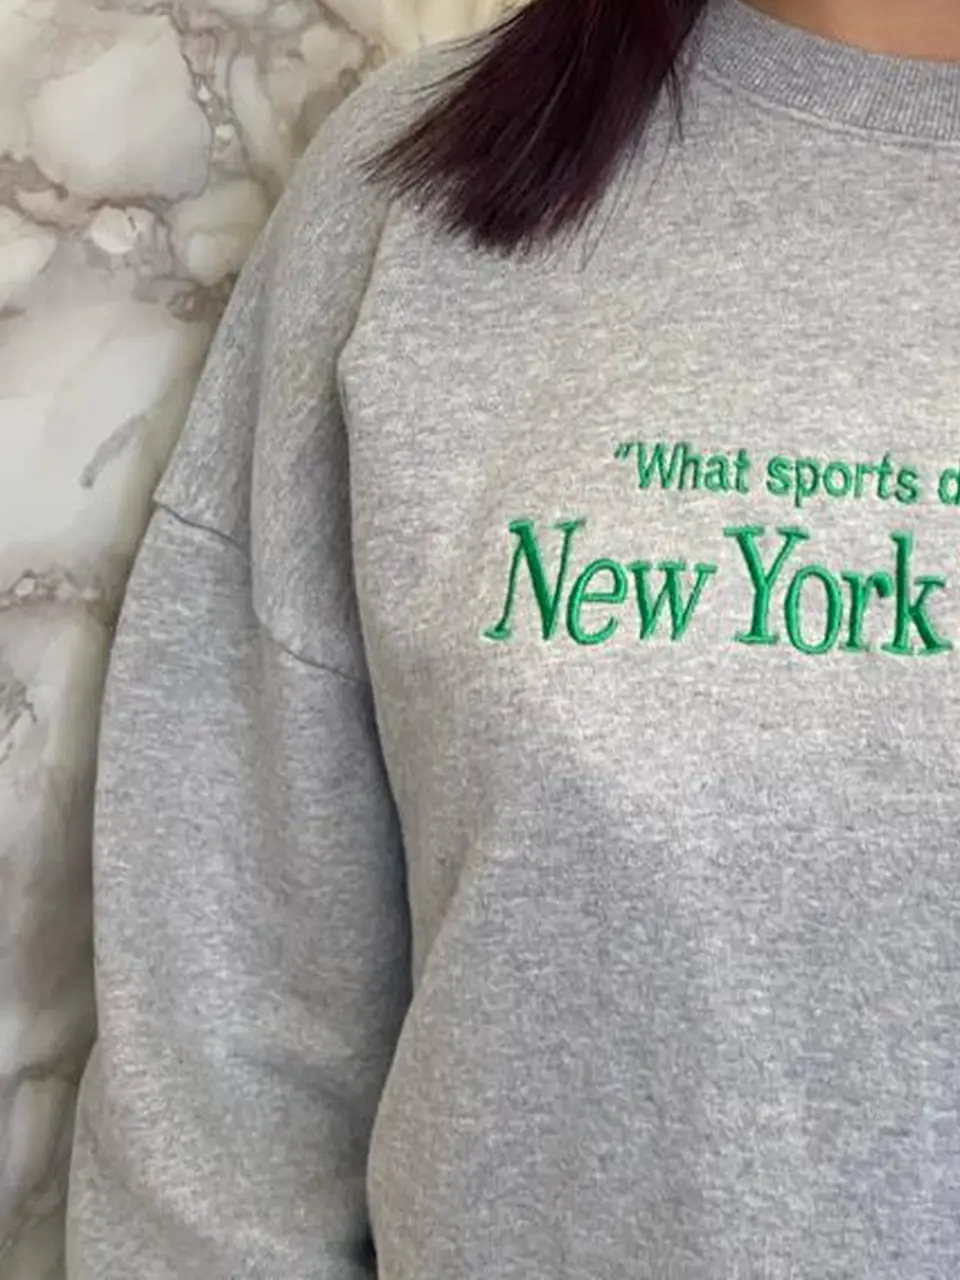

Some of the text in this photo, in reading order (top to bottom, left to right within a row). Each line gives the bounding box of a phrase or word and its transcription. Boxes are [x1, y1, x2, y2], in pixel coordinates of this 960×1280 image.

[616, 442, 753, 497] "What
[766, 455, 923, 508] sports
[483, 520, 720, 647] New
[723, 524, 952, 658] York
